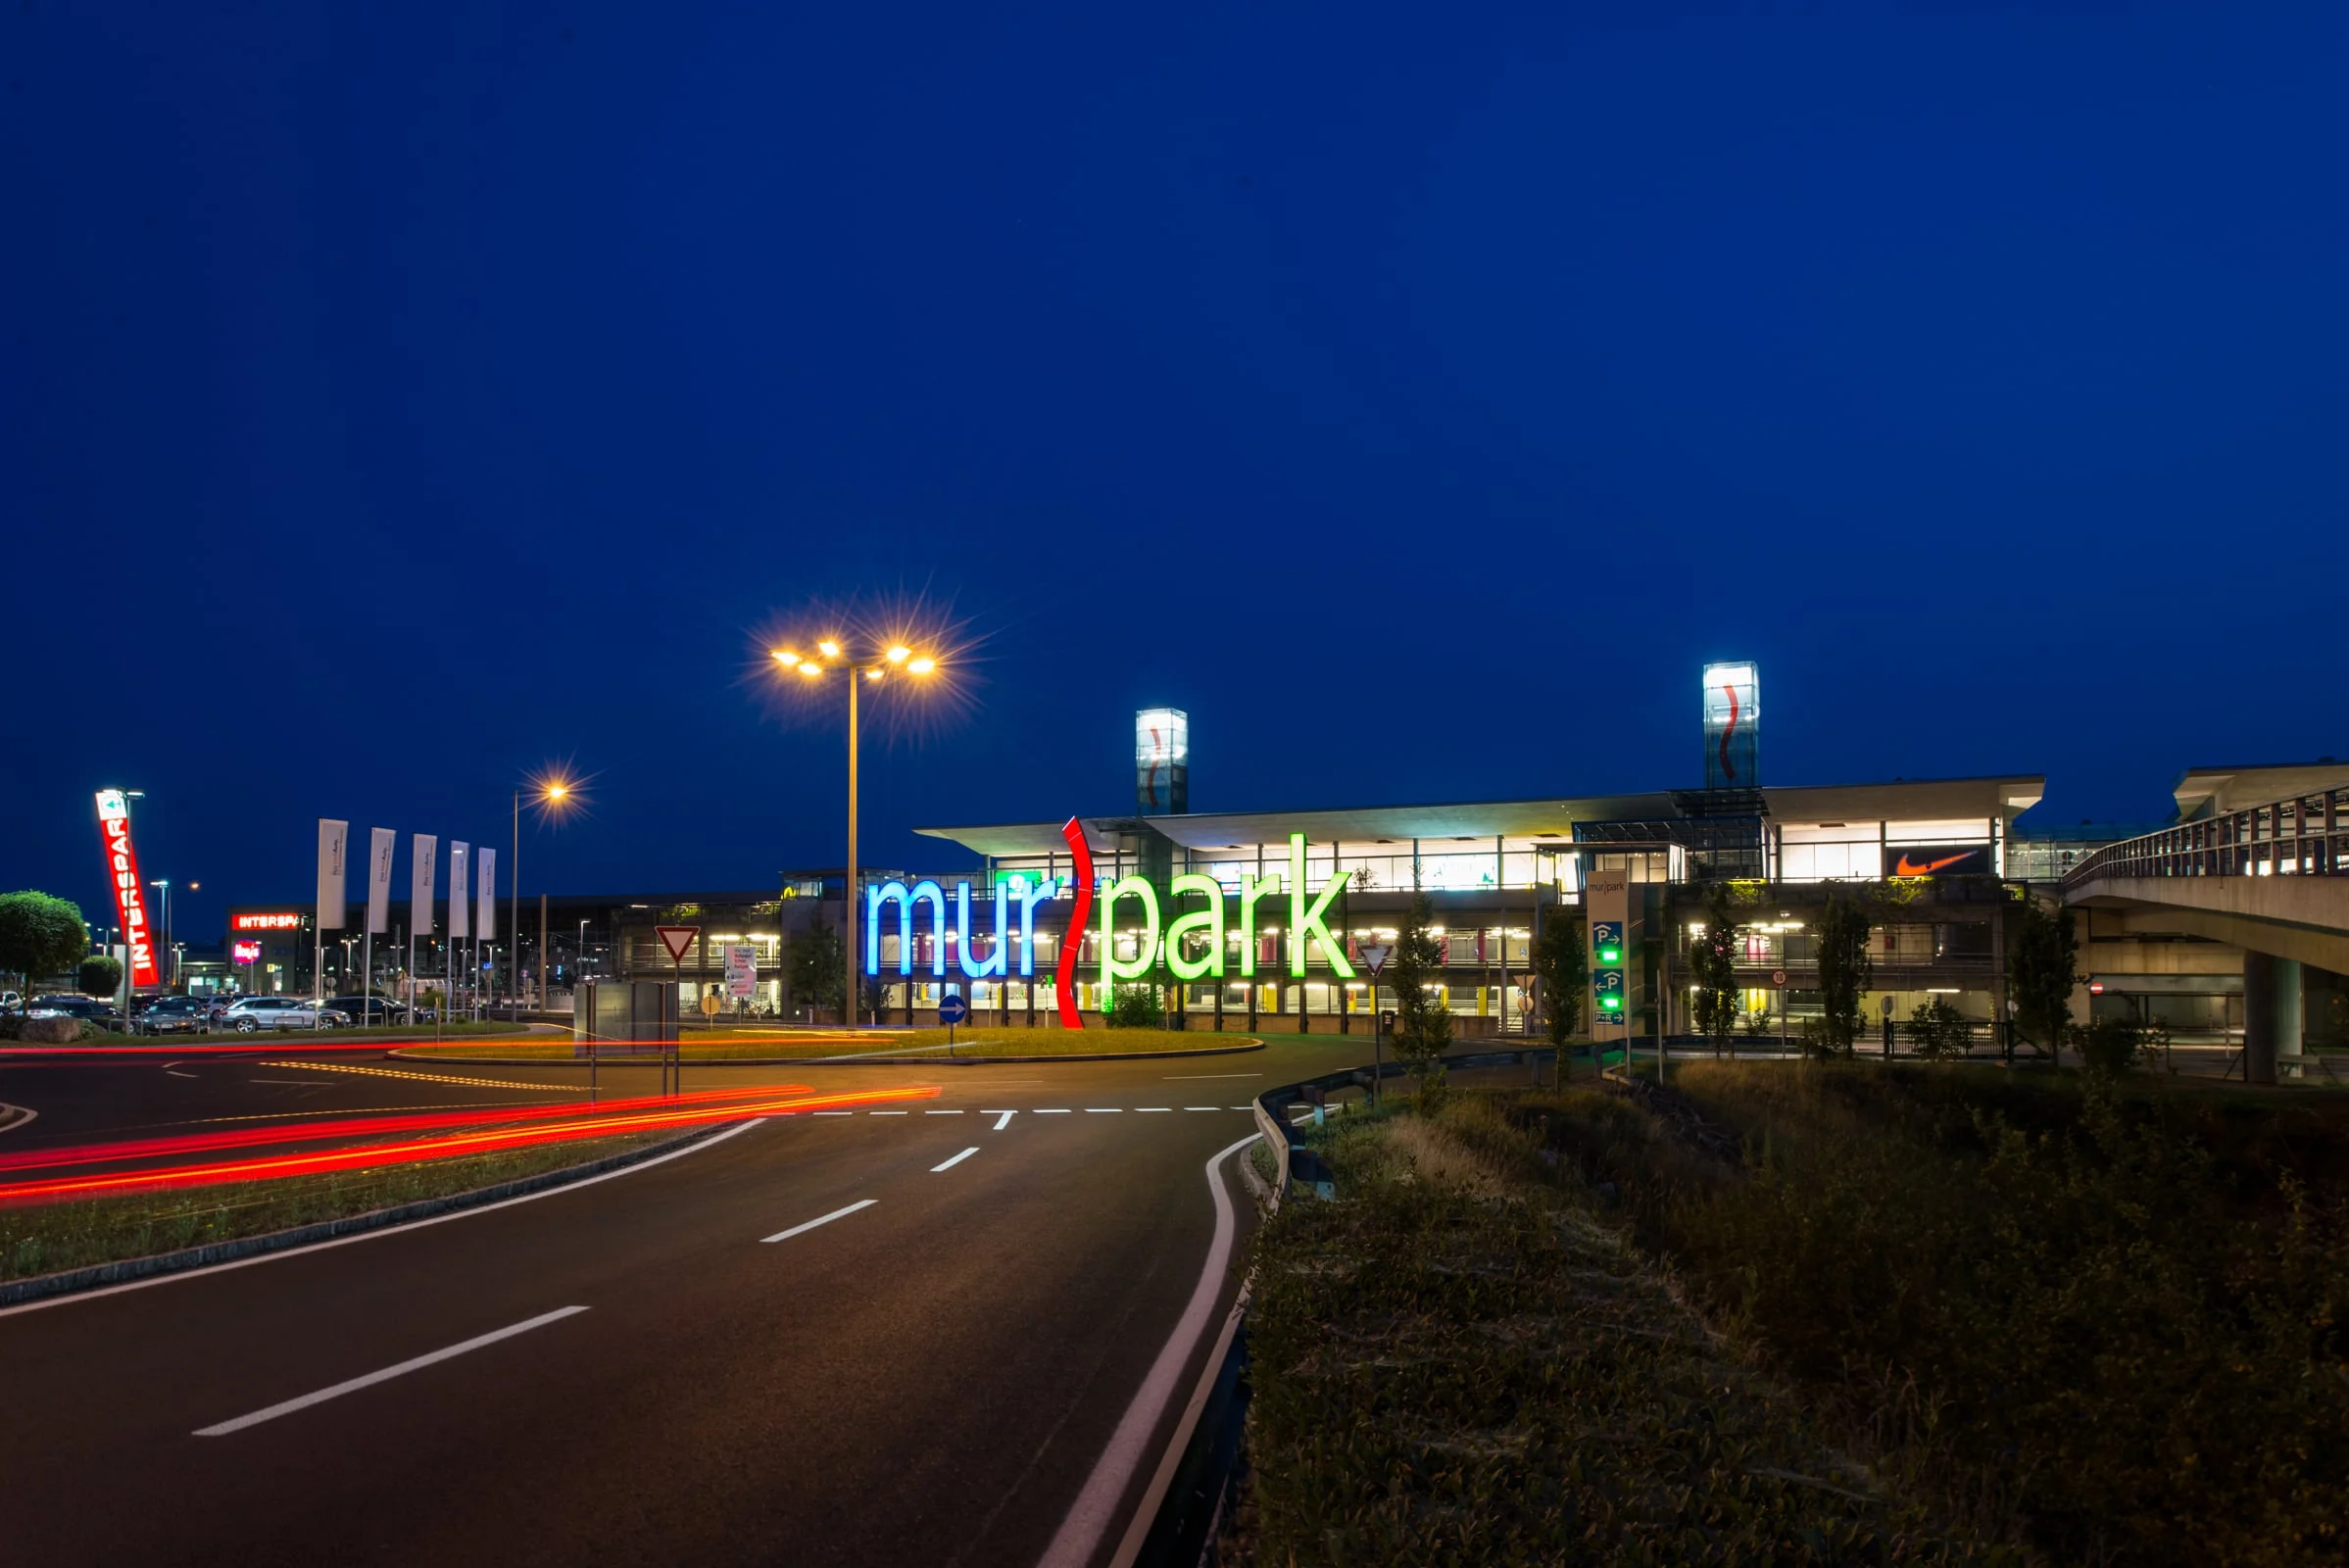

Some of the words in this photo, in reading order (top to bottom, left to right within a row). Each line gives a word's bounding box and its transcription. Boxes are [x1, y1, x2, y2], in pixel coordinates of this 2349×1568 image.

[106, 818, 151, 969] INTERSPAR
[1101, 833, 1356, 1014] park
[1597, 930, 1608, 943] P
[1607, 976, 1618, 990] P
[1776, 972, 1784, 982] 10
